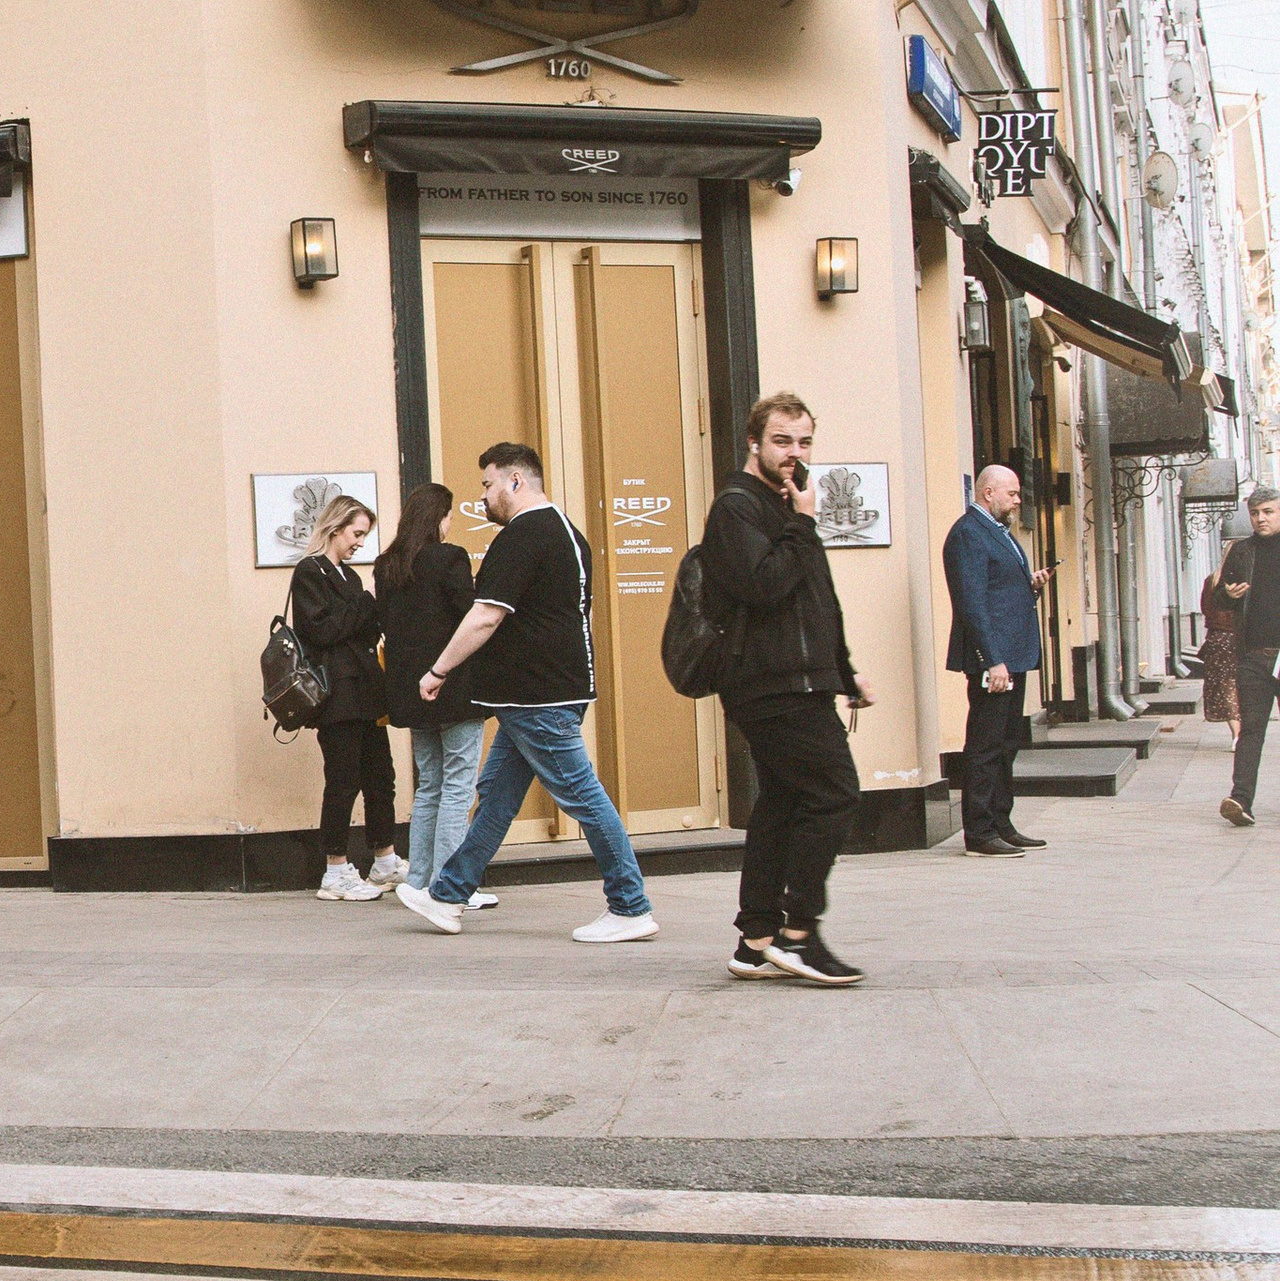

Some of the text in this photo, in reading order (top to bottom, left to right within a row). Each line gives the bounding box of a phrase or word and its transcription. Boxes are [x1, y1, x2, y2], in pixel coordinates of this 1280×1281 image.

[548, 58, 592, 78] 1760
[979, 113, 1055, 140] DIPT
[562, 148, 620, 160] CREED
[418, 187, 688, 205] FROM FATHER TO SON SINCE 1760
[613, 497, 671, 509] REED
[616, 547, 674, 555] ЕКОНСТРУКЦИЮ
